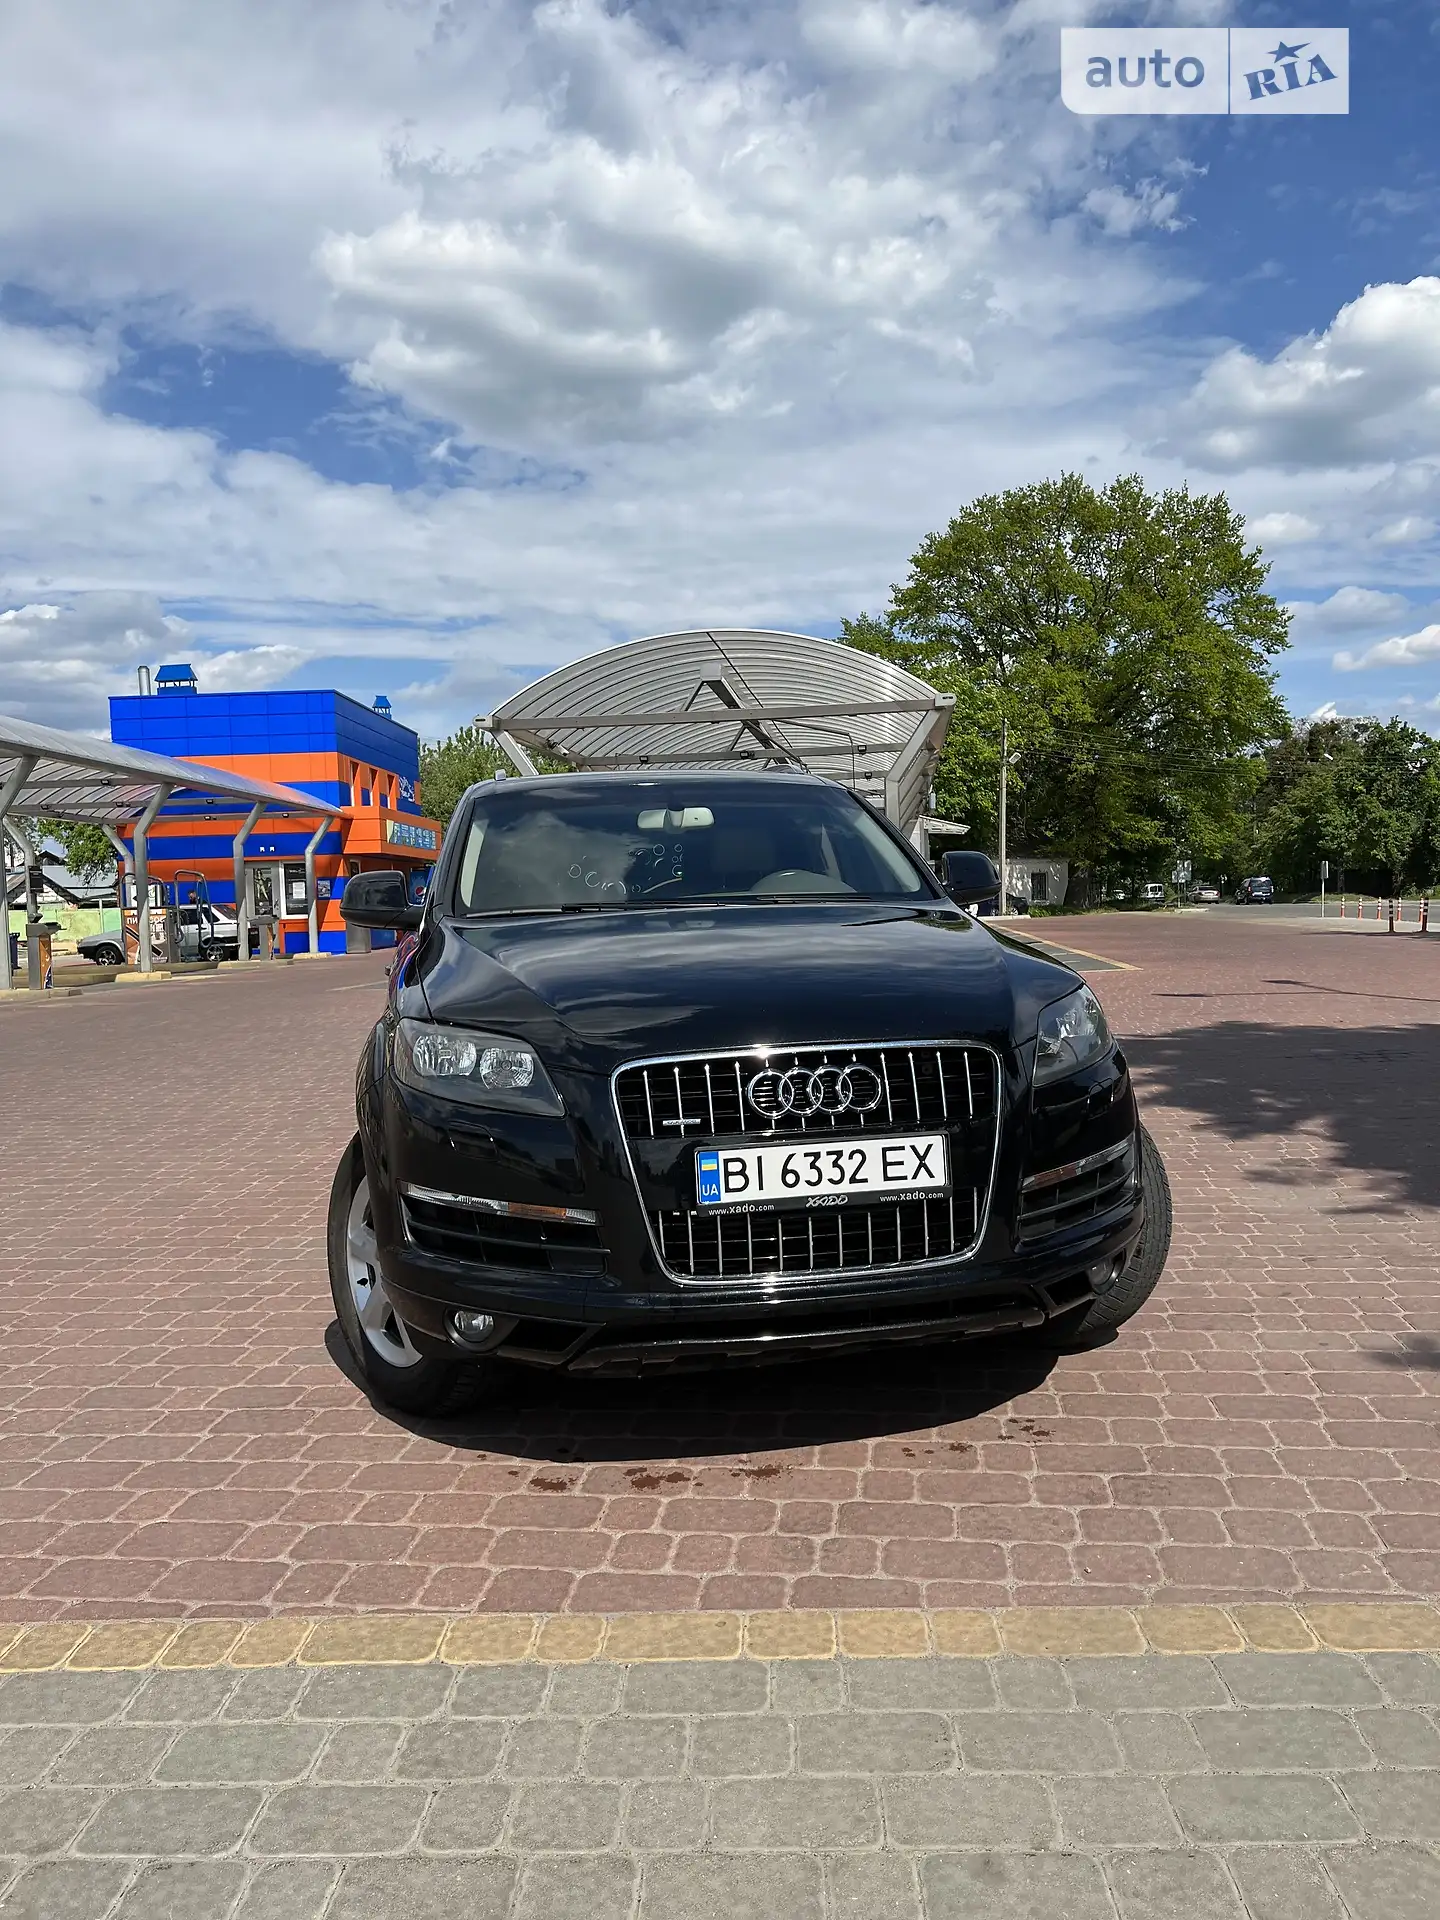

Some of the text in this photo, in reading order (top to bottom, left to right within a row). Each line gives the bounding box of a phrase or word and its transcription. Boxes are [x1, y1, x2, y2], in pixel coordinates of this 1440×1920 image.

[723, 1143, 935, 1193] BI 6332 EX
[702, 1183, 719, 1196] UA
[879, 1190, 944, 1202] www.xado.com
[708, 1203, 775, 1216] www.xado.com
